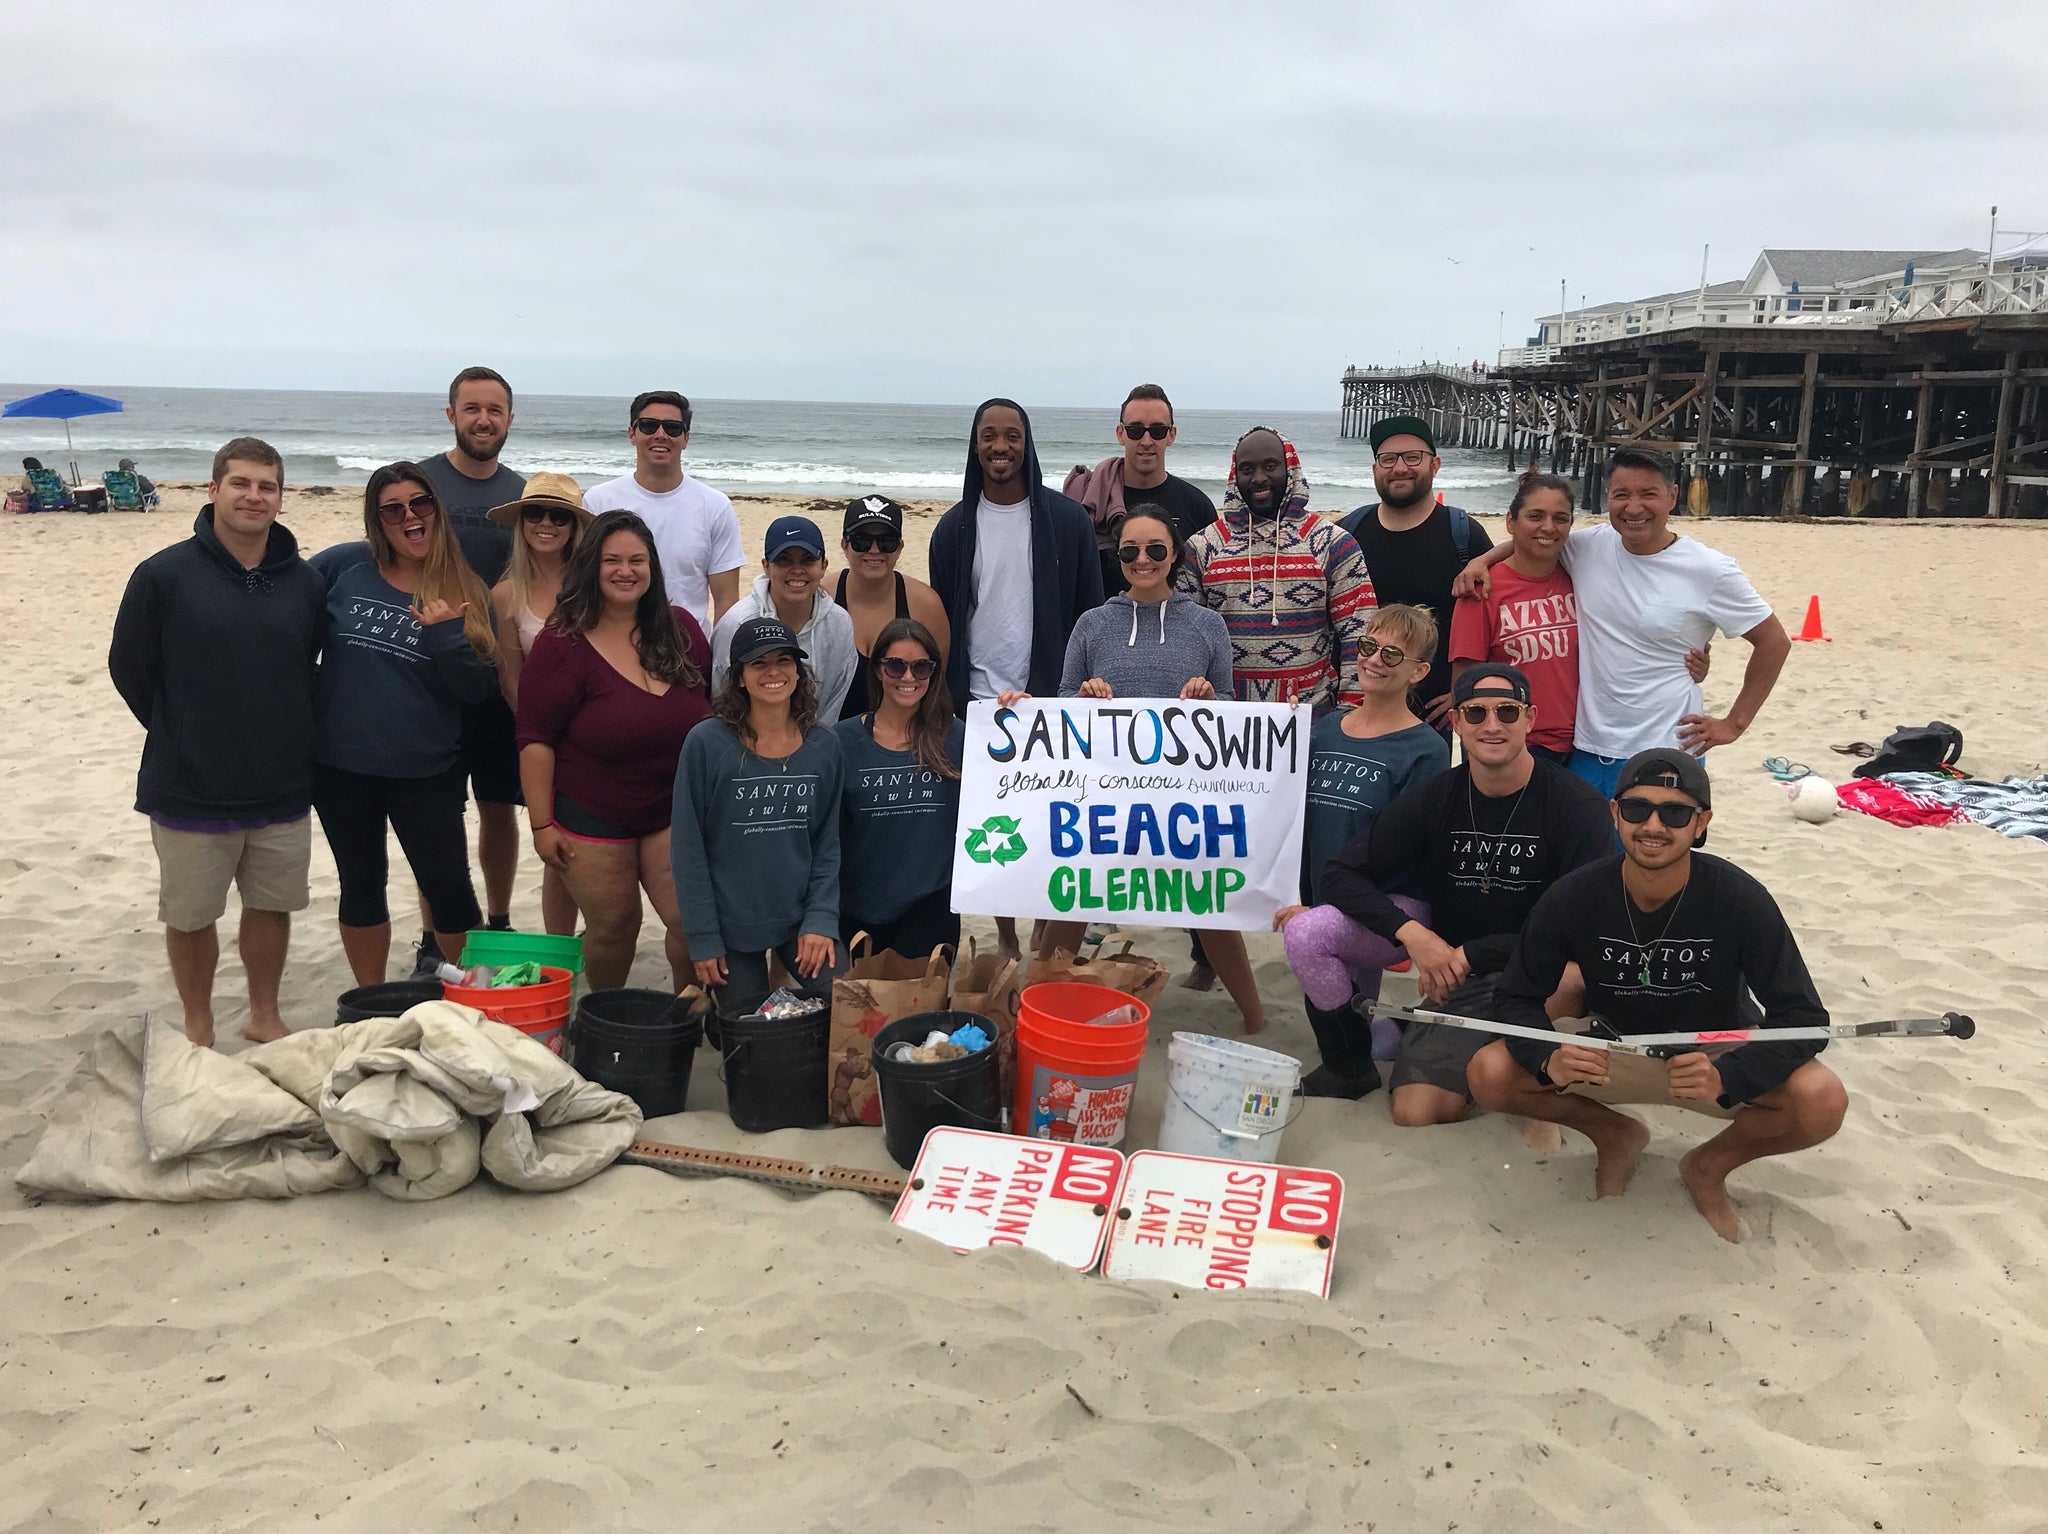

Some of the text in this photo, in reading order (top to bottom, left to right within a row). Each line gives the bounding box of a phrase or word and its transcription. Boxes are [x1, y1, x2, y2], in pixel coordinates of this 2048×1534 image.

[349, 603, 423, 630] SANTO
[1503, 629, 1569, 666] SDSU
[862, 771, 943, 788] SANTOS
[1311, 758, 1381, 782] SANTOS
[735, 783, 816, 800] SANTOS
[872, 788, 933, 802] swim
[1186, 777, 1271, 795] swimwear
[1311, 778, 1360, 794] swim
[748, 801, 808, 817] swim
[1049, 801, 1248, 860] BEACH
[1459, 861, 1520, 875] swim
[1047, 866, 1246, 915] CLEANUP
[1602, 947, 1711, 965] SANTOS
[1080, 1122, 1118, 1139] BUCKET
[1062, 1154, 1115, 1196] NO
[926, 1165, 969, 1213] TIME
[964, 1170, 1001, 1217] ANY
[1279, 1178, 1332, 1226] NO
[1134, 1189, 1175, 1248] LANE
[1173, 1198, 1212, 1249] FIRE
[1205, 1171, 1266, 1289] STOPPING
